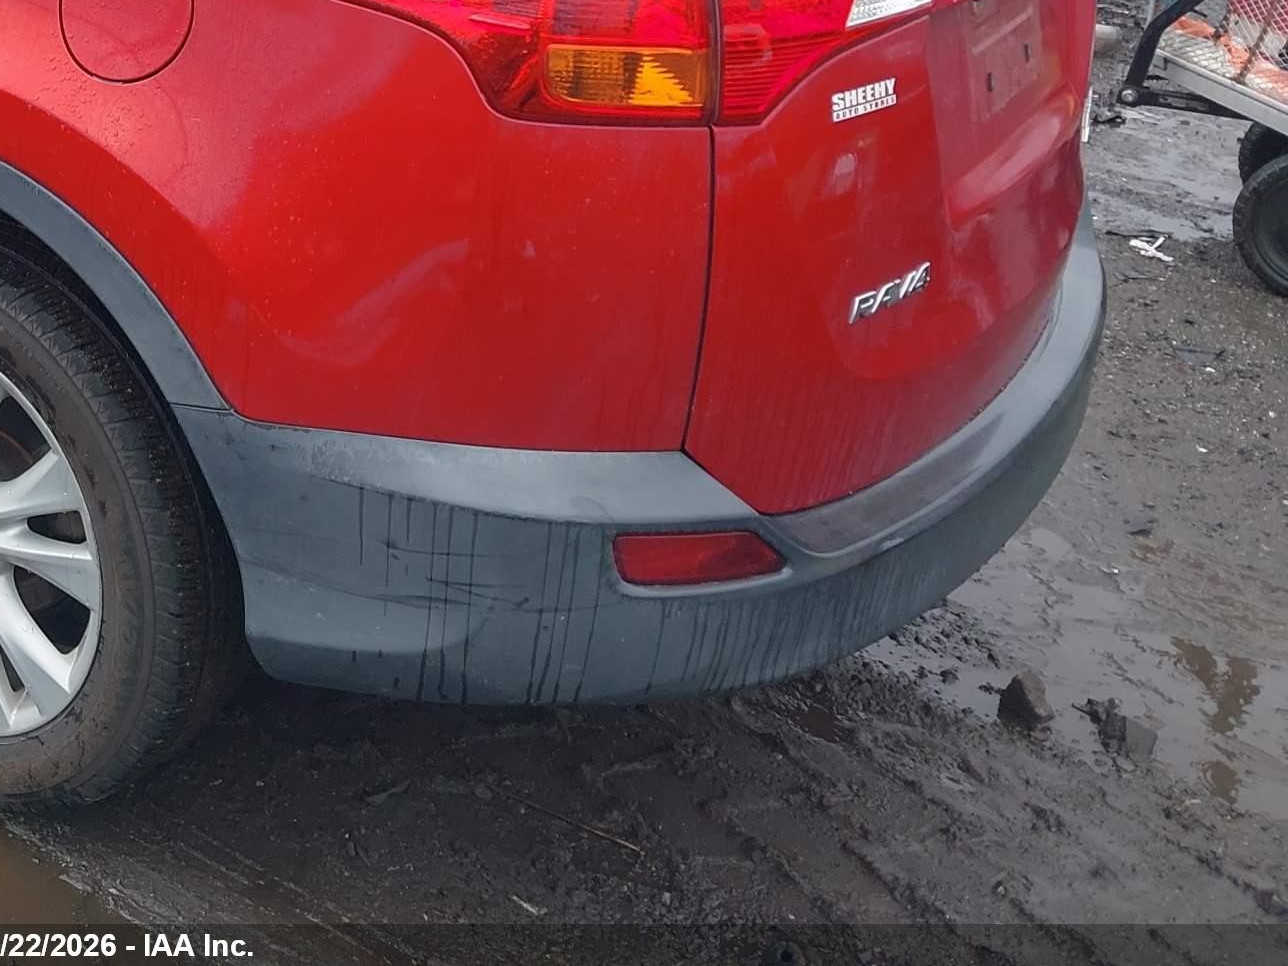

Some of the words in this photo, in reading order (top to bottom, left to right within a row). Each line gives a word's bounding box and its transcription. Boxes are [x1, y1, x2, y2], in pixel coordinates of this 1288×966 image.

[831, 77, 896, 111] SHEEHY
[835, 107, 860, 120] AUTO
[849, 262, 931, 324] RAV4
